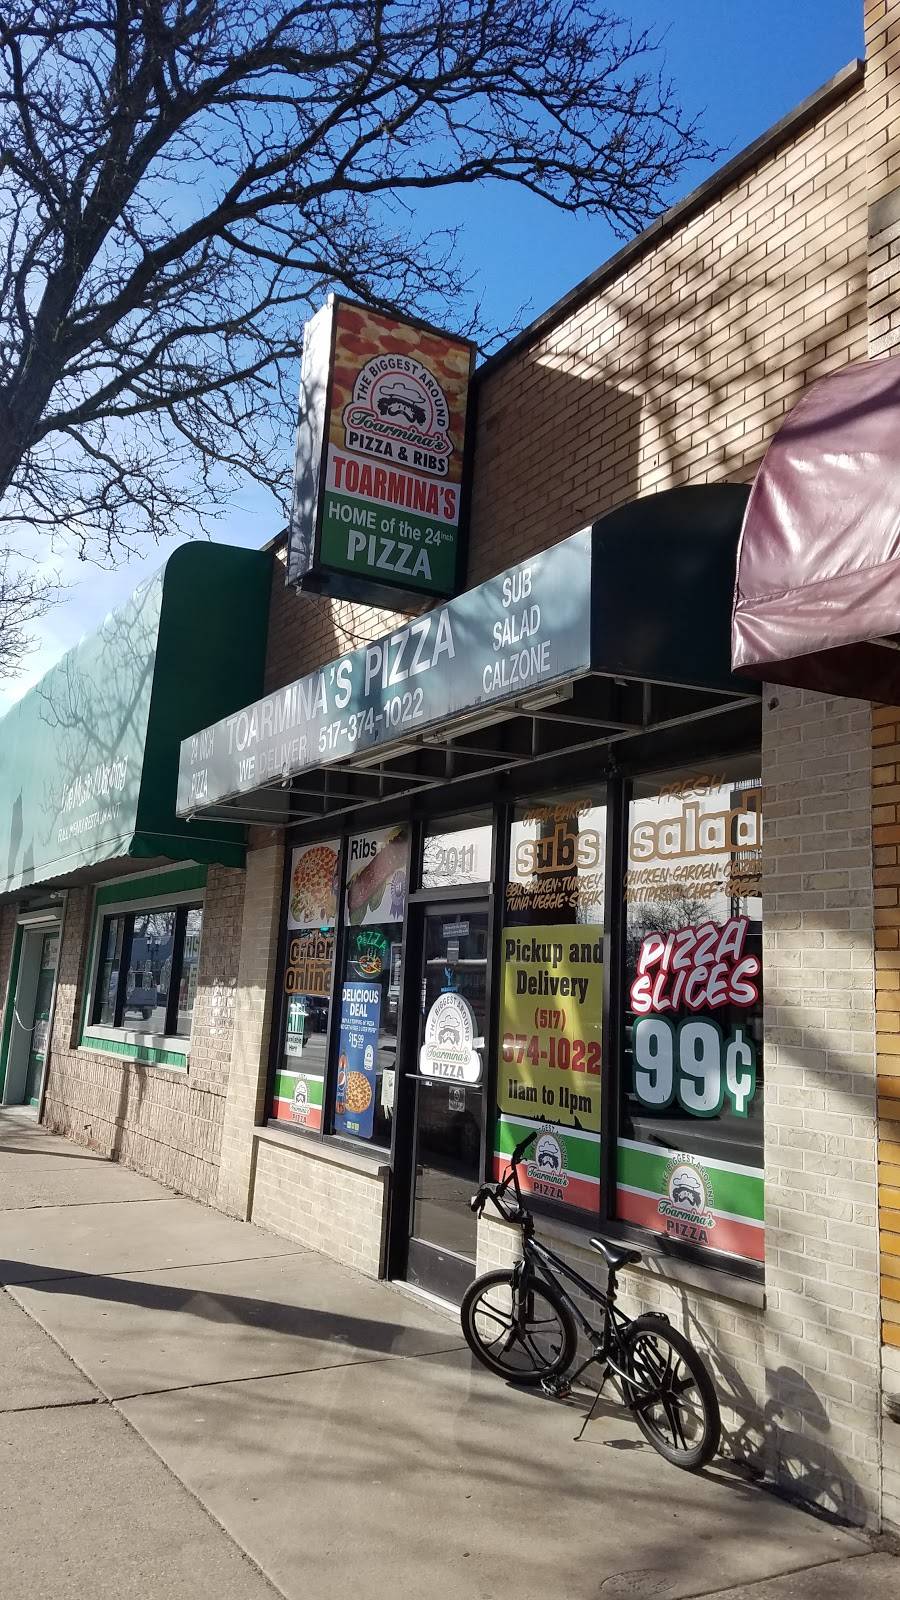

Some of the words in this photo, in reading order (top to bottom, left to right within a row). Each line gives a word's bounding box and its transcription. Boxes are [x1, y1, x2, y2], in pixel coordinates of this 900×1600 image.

[356, 374, 372, 401] THE
[368, 358, 419, 378] BIGGEST
[418, 372, 446, 427] AROUND
[350, 410, 447, 450] Toarmina's
[348, 431, 393, 457] PIZZA
[397, 446, 409, 462] &
[413, 452, 446, 472] RIBS
[332, 455, 456, 520] TOARMINA'S
[328, 500, 377, 530] HOME
[380, 517, 396, 534] of
[398, 521, 422, 541] the
[346, 529, 432, 580] PIZZA
[501, 567, 532, 608] SUB
[492, 604, 541, 651] SALAD
[226, 659, 353, 755] TOARMINA'S
[364, 607, 456, 697] PIZZA
[482, 640, 551, 694] CALZONE
[239, 755, 256, 782] WE
[259, 735, 308, 773] DELIVER
[318, 687, 424, 753] 517-374-1022
[191, 768, 208, 800] PIZZA
[657, 773, 726, 804] FRESH
[350, 838, 377, 860] Ribs
[434, 843, 474, 877] 2011
[515, 822, 600, 877] subs
[290, 932, 333, 965] order
[505, 938, 564, 969] Pickup
[568, 938, 604, 964] and
[638, 917, 749, 976] PIZZA
[342, 988, 379, 1004] DELICIOUS
[516, 970, 590, 1005] Delivery
[630, 957, 759, 1013] SLICES
[350, 1003, 368, 1018] DEAL
[434, 995, 457, 1016] BIGGEST
[456, 1000, 470, 1042] AROUND
[534, 1007, 567, 1032] (517)
[426, 1044, 469, 1062] Toarmina's
[432, 1062, 465, 1080] PIZZA
[635, 1018, 752, 1113] 99¢
[508, 1079, 538, 1103] 11am
[542, 1084, 555, 1106] to
[559, 1086, 592, 1114] 11pm
[527, 1165, 569, 1186] Toarmina's
[533, 1181, 564, 1200] PIZZA
[666, 1153, 696, 1172] BIGGEST
[693, 1161, 714, 1206] AROUND
[658, 1200, 714, 1227] Toarmina's
[666, 1218, 709, 1243] PIZZA
